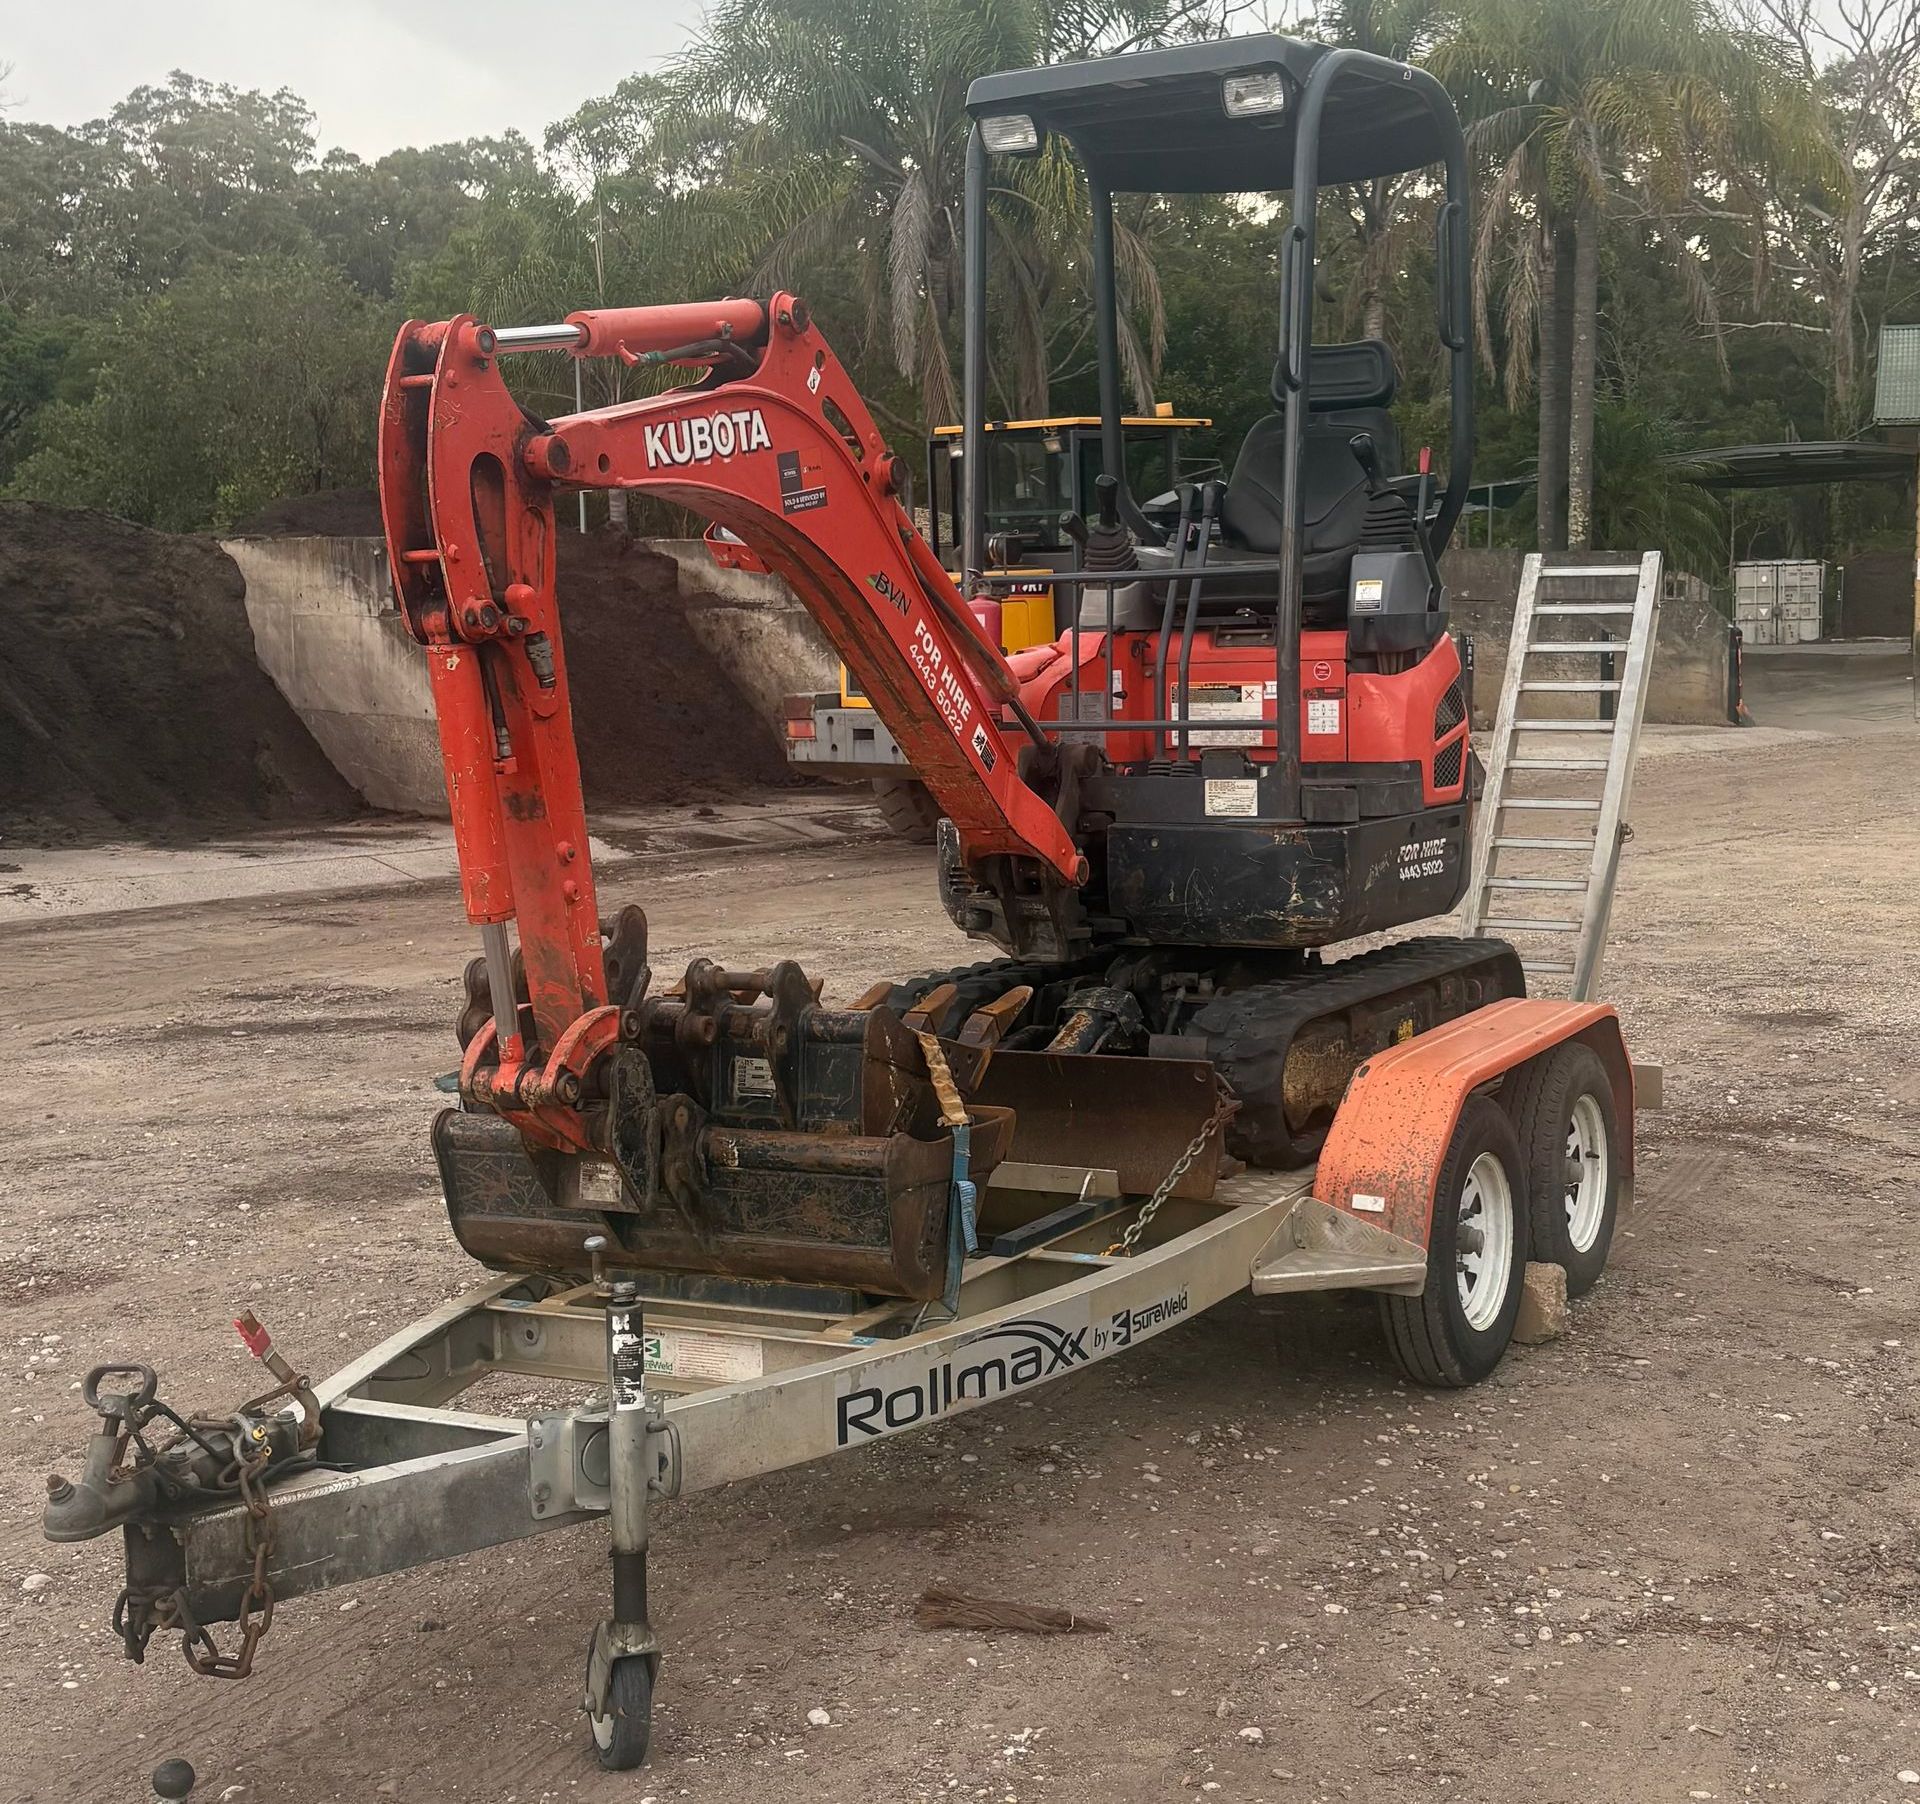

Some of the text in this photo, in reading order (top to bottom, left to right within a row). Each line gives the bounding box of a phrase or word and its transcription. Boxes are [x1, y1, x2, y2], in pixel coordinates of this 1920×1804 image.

[644, 409, 772, 468] KUBOTA
[909, 644, 964, 737] 4443 5022
[914, 618, 972, 722] FOR HIRE
[1397, 838, 1446, 863] FOR HIRE
[1399, 864, 1421, 881] 4443
[1421, 859, 1444, 877] 5022
[1094, 1326, 1109, 1351] by
[1132, 1290, 1188, 1334] SureWeld
